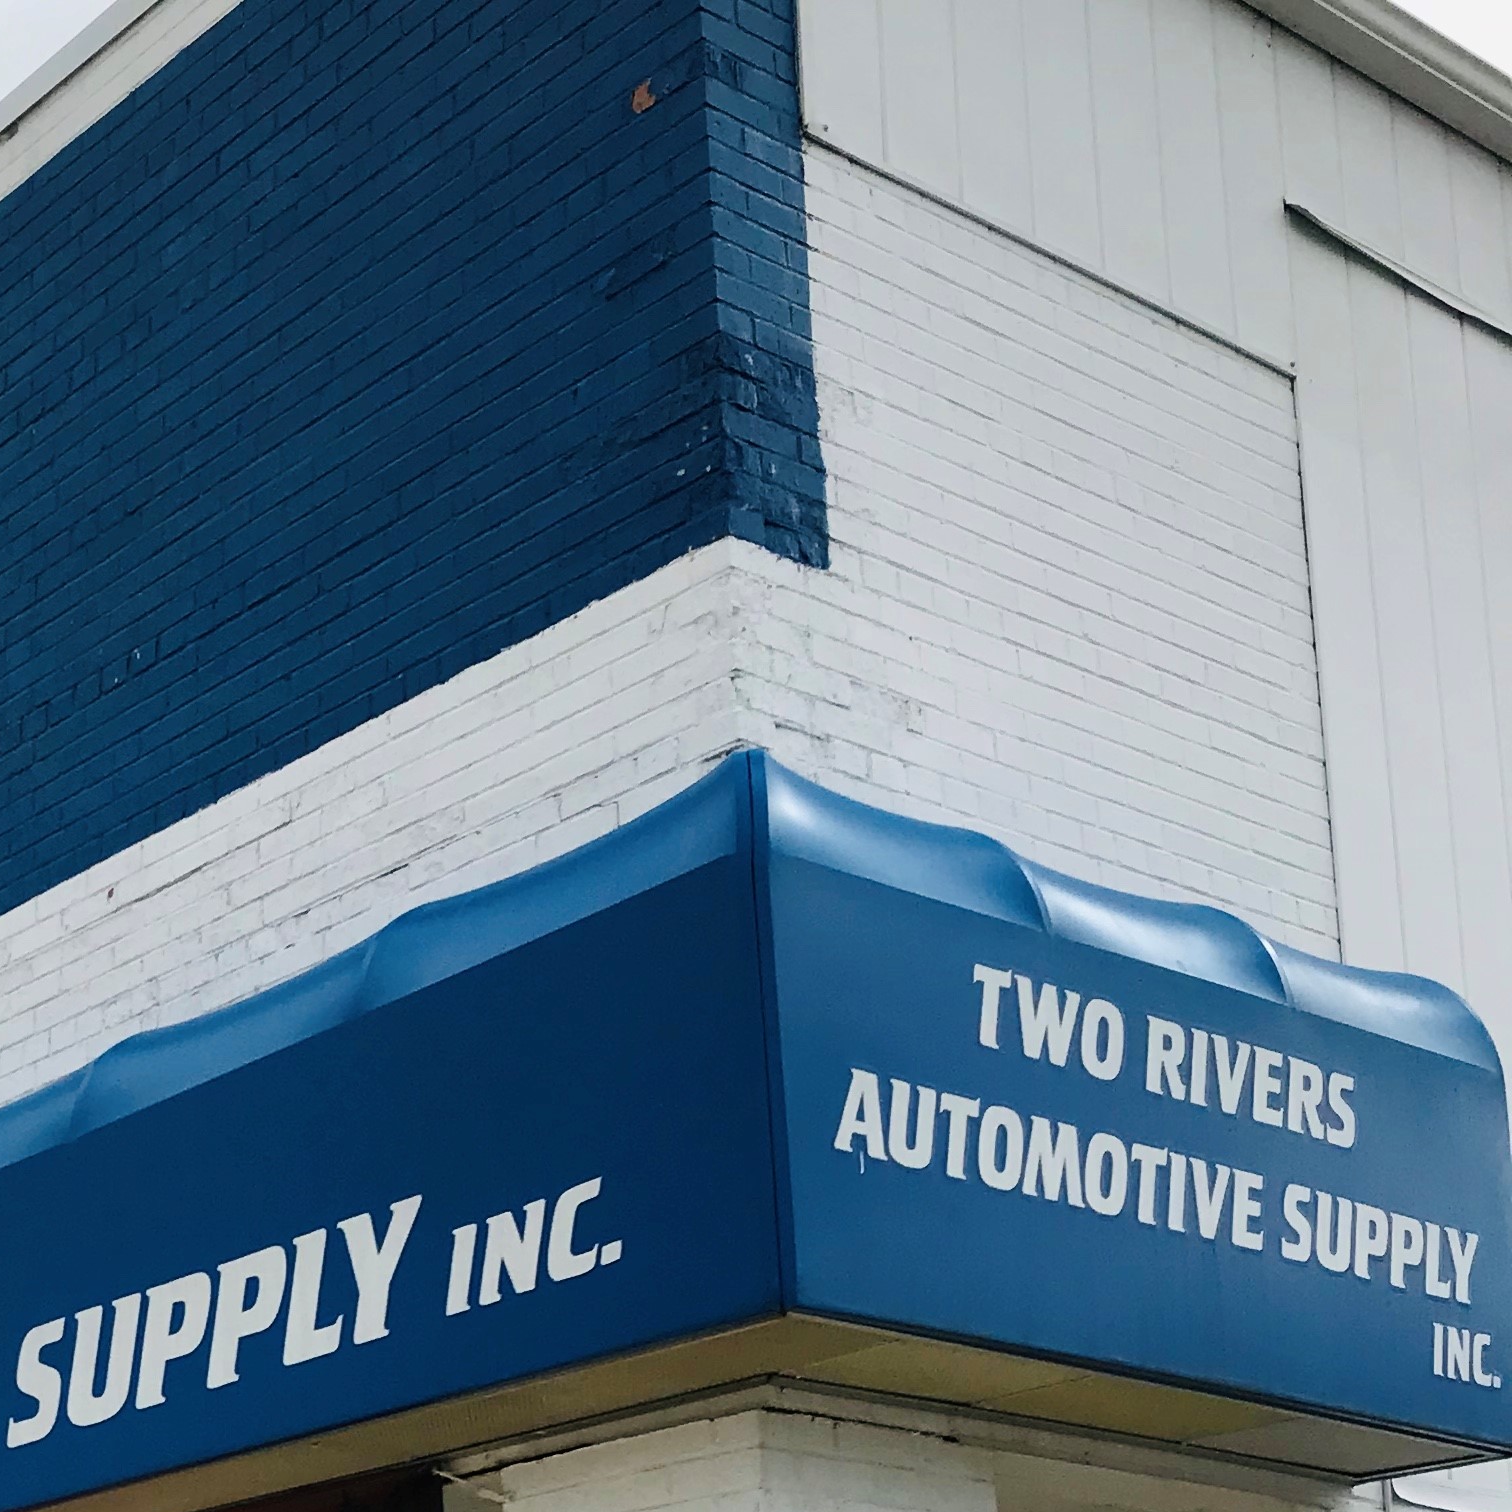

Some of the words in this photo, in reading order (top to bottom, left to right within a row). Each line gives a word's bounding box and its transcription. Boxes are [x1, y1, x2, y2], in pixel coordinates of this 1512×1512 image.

[973, 962, 1124, 1081] TWO
[1145, 1014, 1356, 1149] RIVERS
[833, 1067, 1264, 1252] AUTOMOTIVE
[1281, 1183, 1480, 1305] SUPPLY
[6, 1194, 422, 1449] SUPPLY
[445, 1176, 622, 1316] INC.
[1433, 1321, 1502, 1389] INC.
